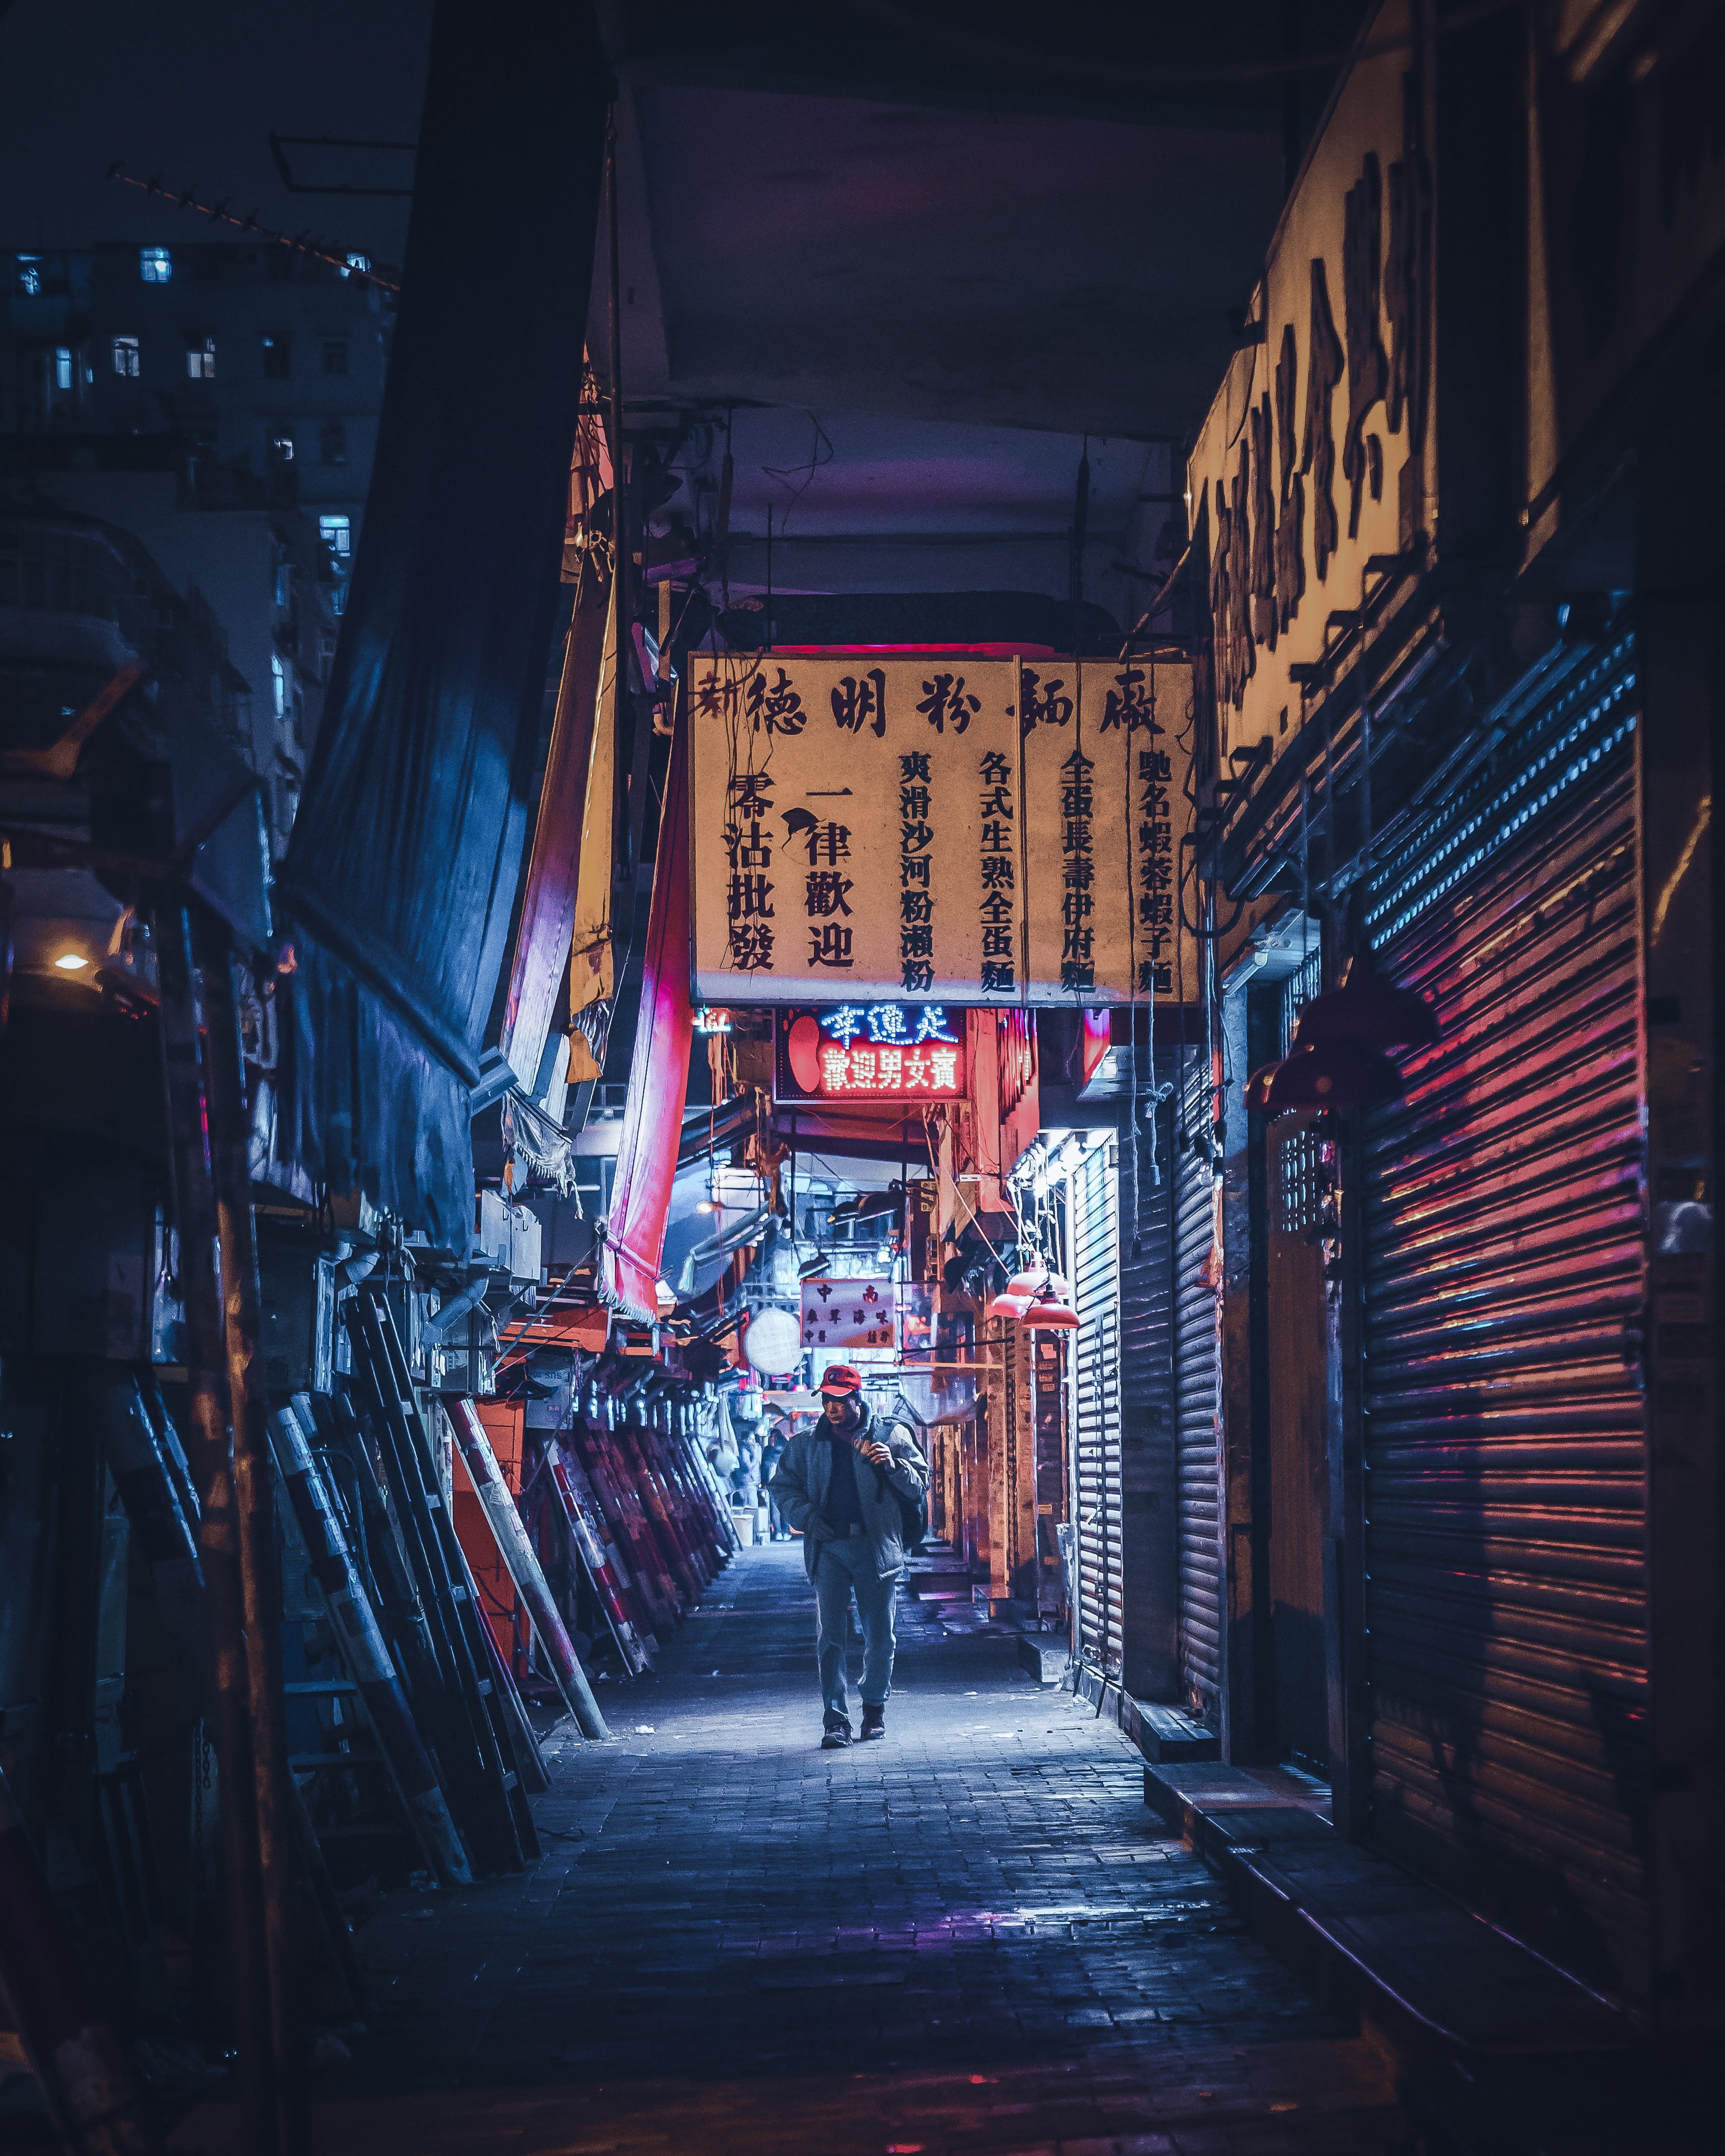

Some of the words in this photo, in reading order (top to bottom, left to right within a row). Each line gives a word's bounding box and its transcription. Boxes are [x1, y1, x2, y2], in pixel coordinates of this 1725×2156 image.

[721, 772, 775, 970] 零沽批發
[804, 787, 854, 967] 一律歡迎
[898, 752, 935, 992] 爽滑沙河粉瀨粉
[979, 752, 1016, 992] 各式生熟全蛋麵
[1061, 751, 1096, 993] 全蛋長壽伊府麵
[1139, 751, 1173, 993] 馳名蝦蓉蝦子麵
